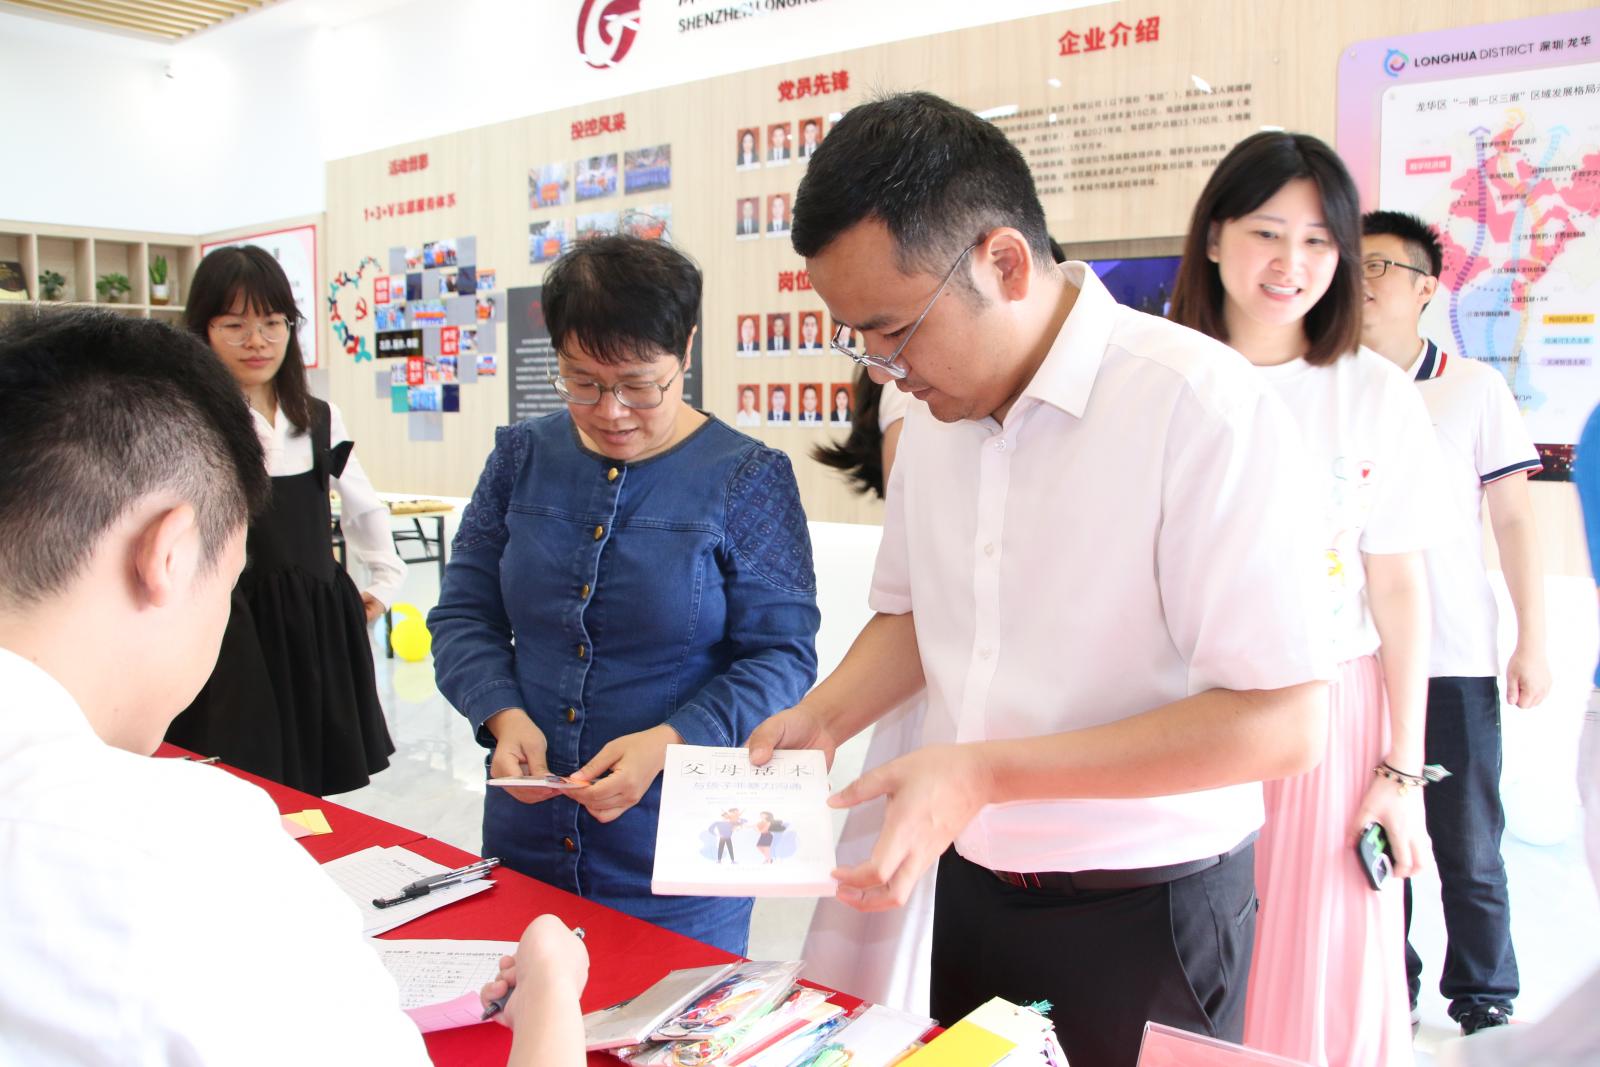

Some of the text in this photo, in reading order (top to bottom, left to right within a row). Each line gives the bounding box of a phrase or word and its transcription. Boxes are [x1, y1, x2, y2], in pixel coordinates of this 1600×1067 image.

[1058, 16, 1160, 56] 企业介绍
[1414, 51, 1477, 68] LONGHUA
[1480, 43, 1535, 60] DISTRICT
[778, 70, 849, 102] 党员先锋
[778, 271, 813, 292] 岗位
